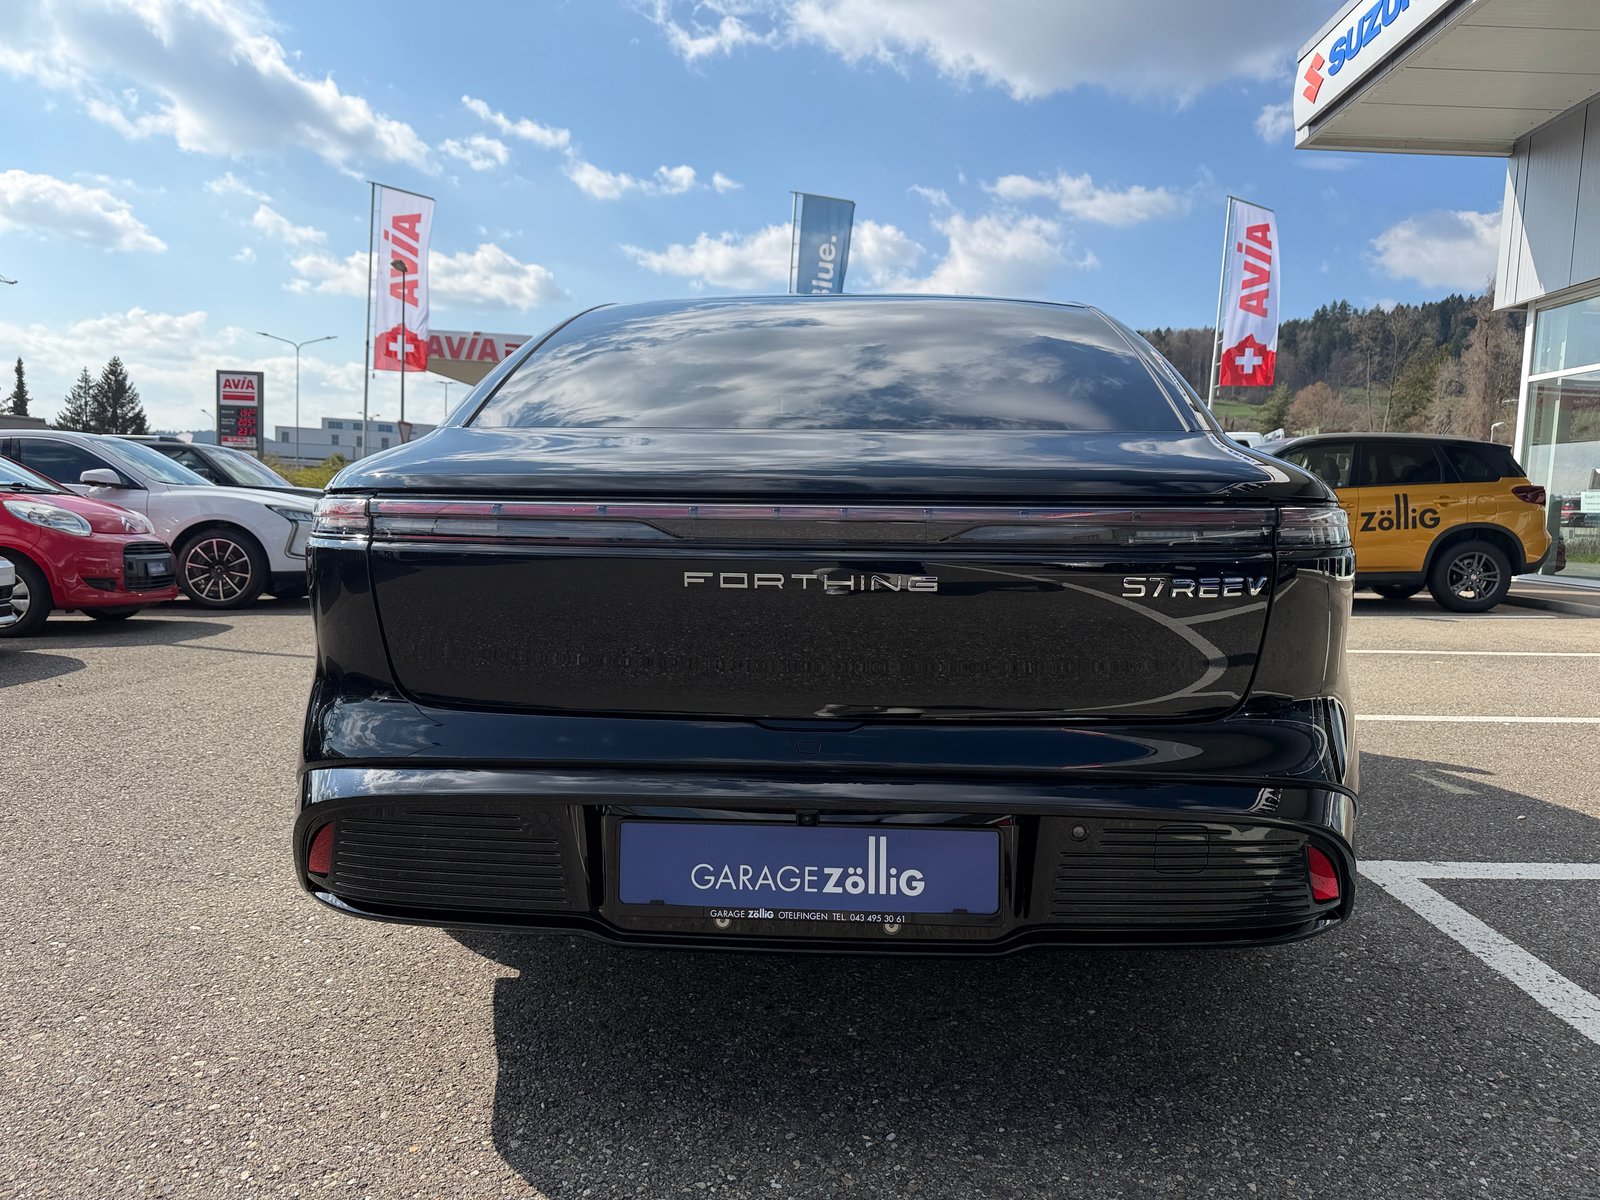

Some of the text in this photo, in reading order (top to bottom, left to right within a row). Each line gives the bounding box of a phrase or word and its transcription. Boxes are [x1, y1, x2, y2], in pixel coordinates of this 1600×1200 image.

[1328, 0, 1410, 76] SUZU
[384, 213, 422, 307] AVIA
[811, 235, 837, 293] lue.
[1237, 223, 1272, 318] AVIA
[427, 331, 500, 362] AVIA
[223, 376, 255, 390] AVIA
[684, 571, 939, 593] FORTHING
[691, 863, 819, 892] GARAGE
[710, 909, 746, 918] GARAGE
[778, 911, 828, 921] OTELFINGEN
[849, 913, 865, 922] 043
[867, 914, 882, 923] 495
[884, 914, 894, 923] 30
[896, 915, 905, 924] 61
